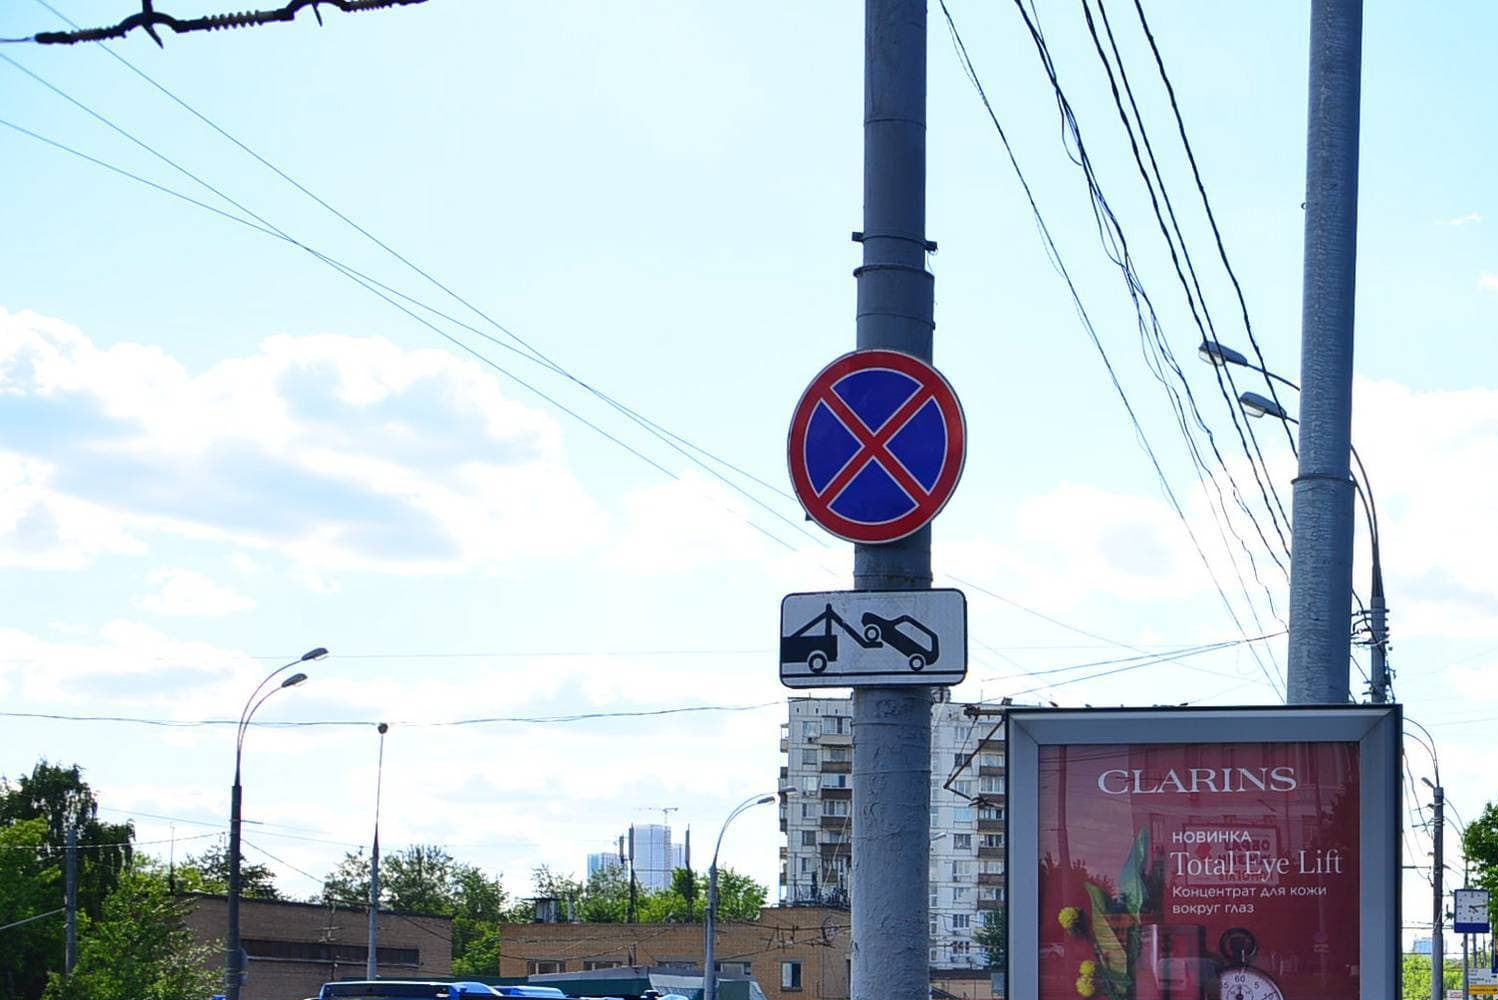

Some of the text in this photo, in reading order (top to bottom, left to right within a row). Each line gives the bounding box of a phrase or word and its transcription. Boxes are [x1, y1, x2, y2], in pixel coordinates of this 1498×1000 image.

[1098, 767, 1297, 794] CLARINS
[1172, 830, 1252, 844] НОВИНКА
[1170, 850, 1233, 876] Total
[1246, 851, 1290, 882] Eye
[1299, 849, 1343, 875] Lift
[1172, 886, 1327, 899] Концентрат для кожи
[1172, 903, 1255, 915] вокруг глаз
